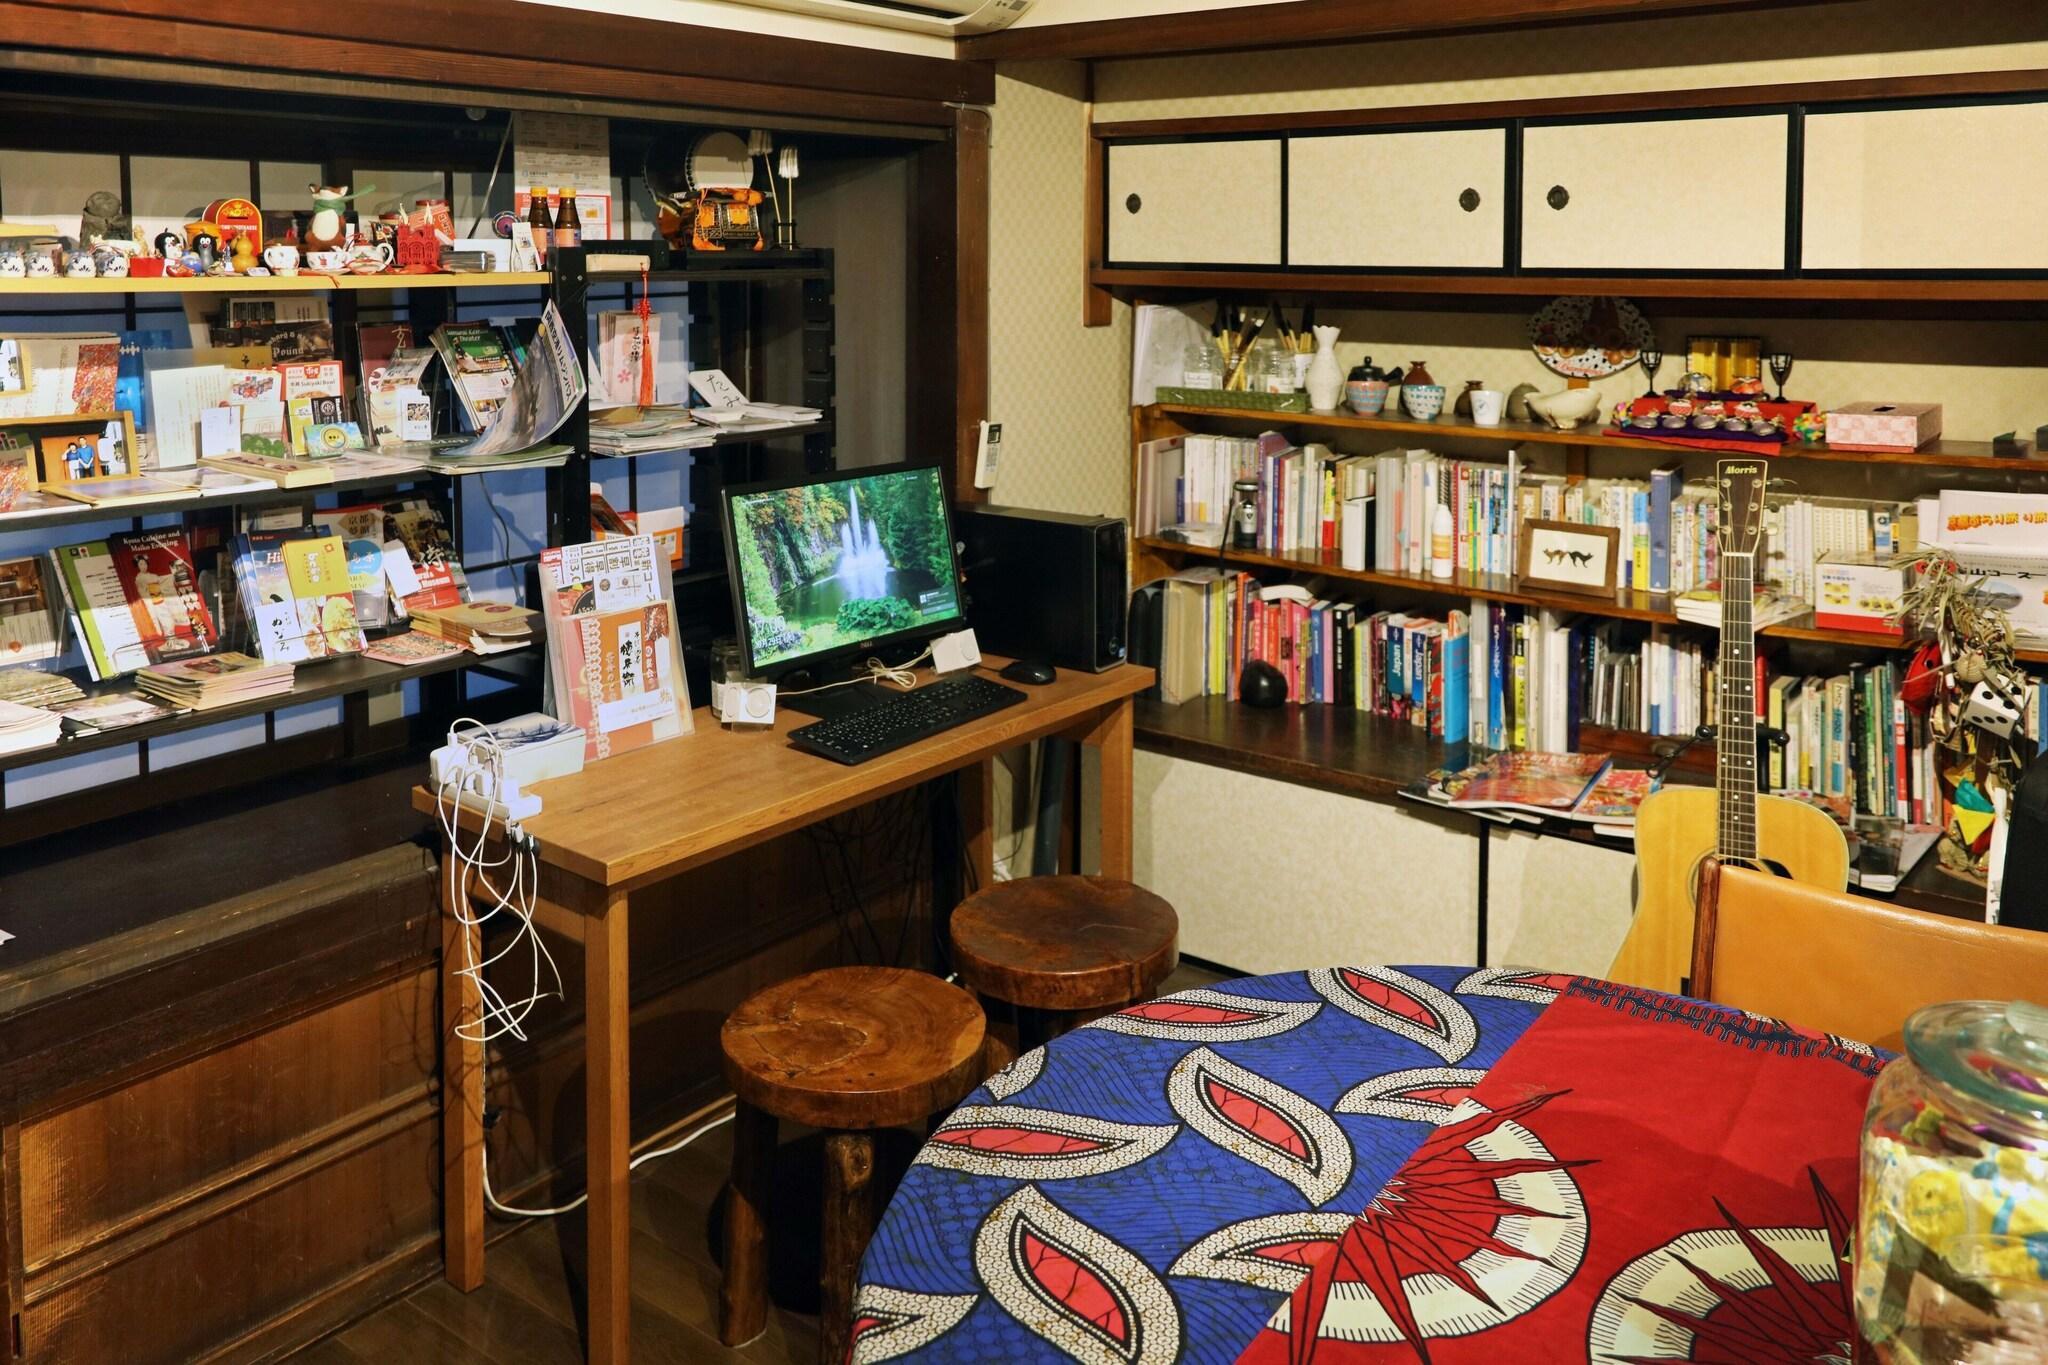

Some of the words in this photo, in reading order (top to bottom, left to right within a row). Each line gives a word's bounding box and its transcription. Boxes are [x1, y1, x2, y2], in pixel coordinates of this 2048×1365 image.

[1724, 465, 1758, 475] Morris
[1392, 644, 1402, 677] Japan
[1415, 650, 1425, 681] Japan
